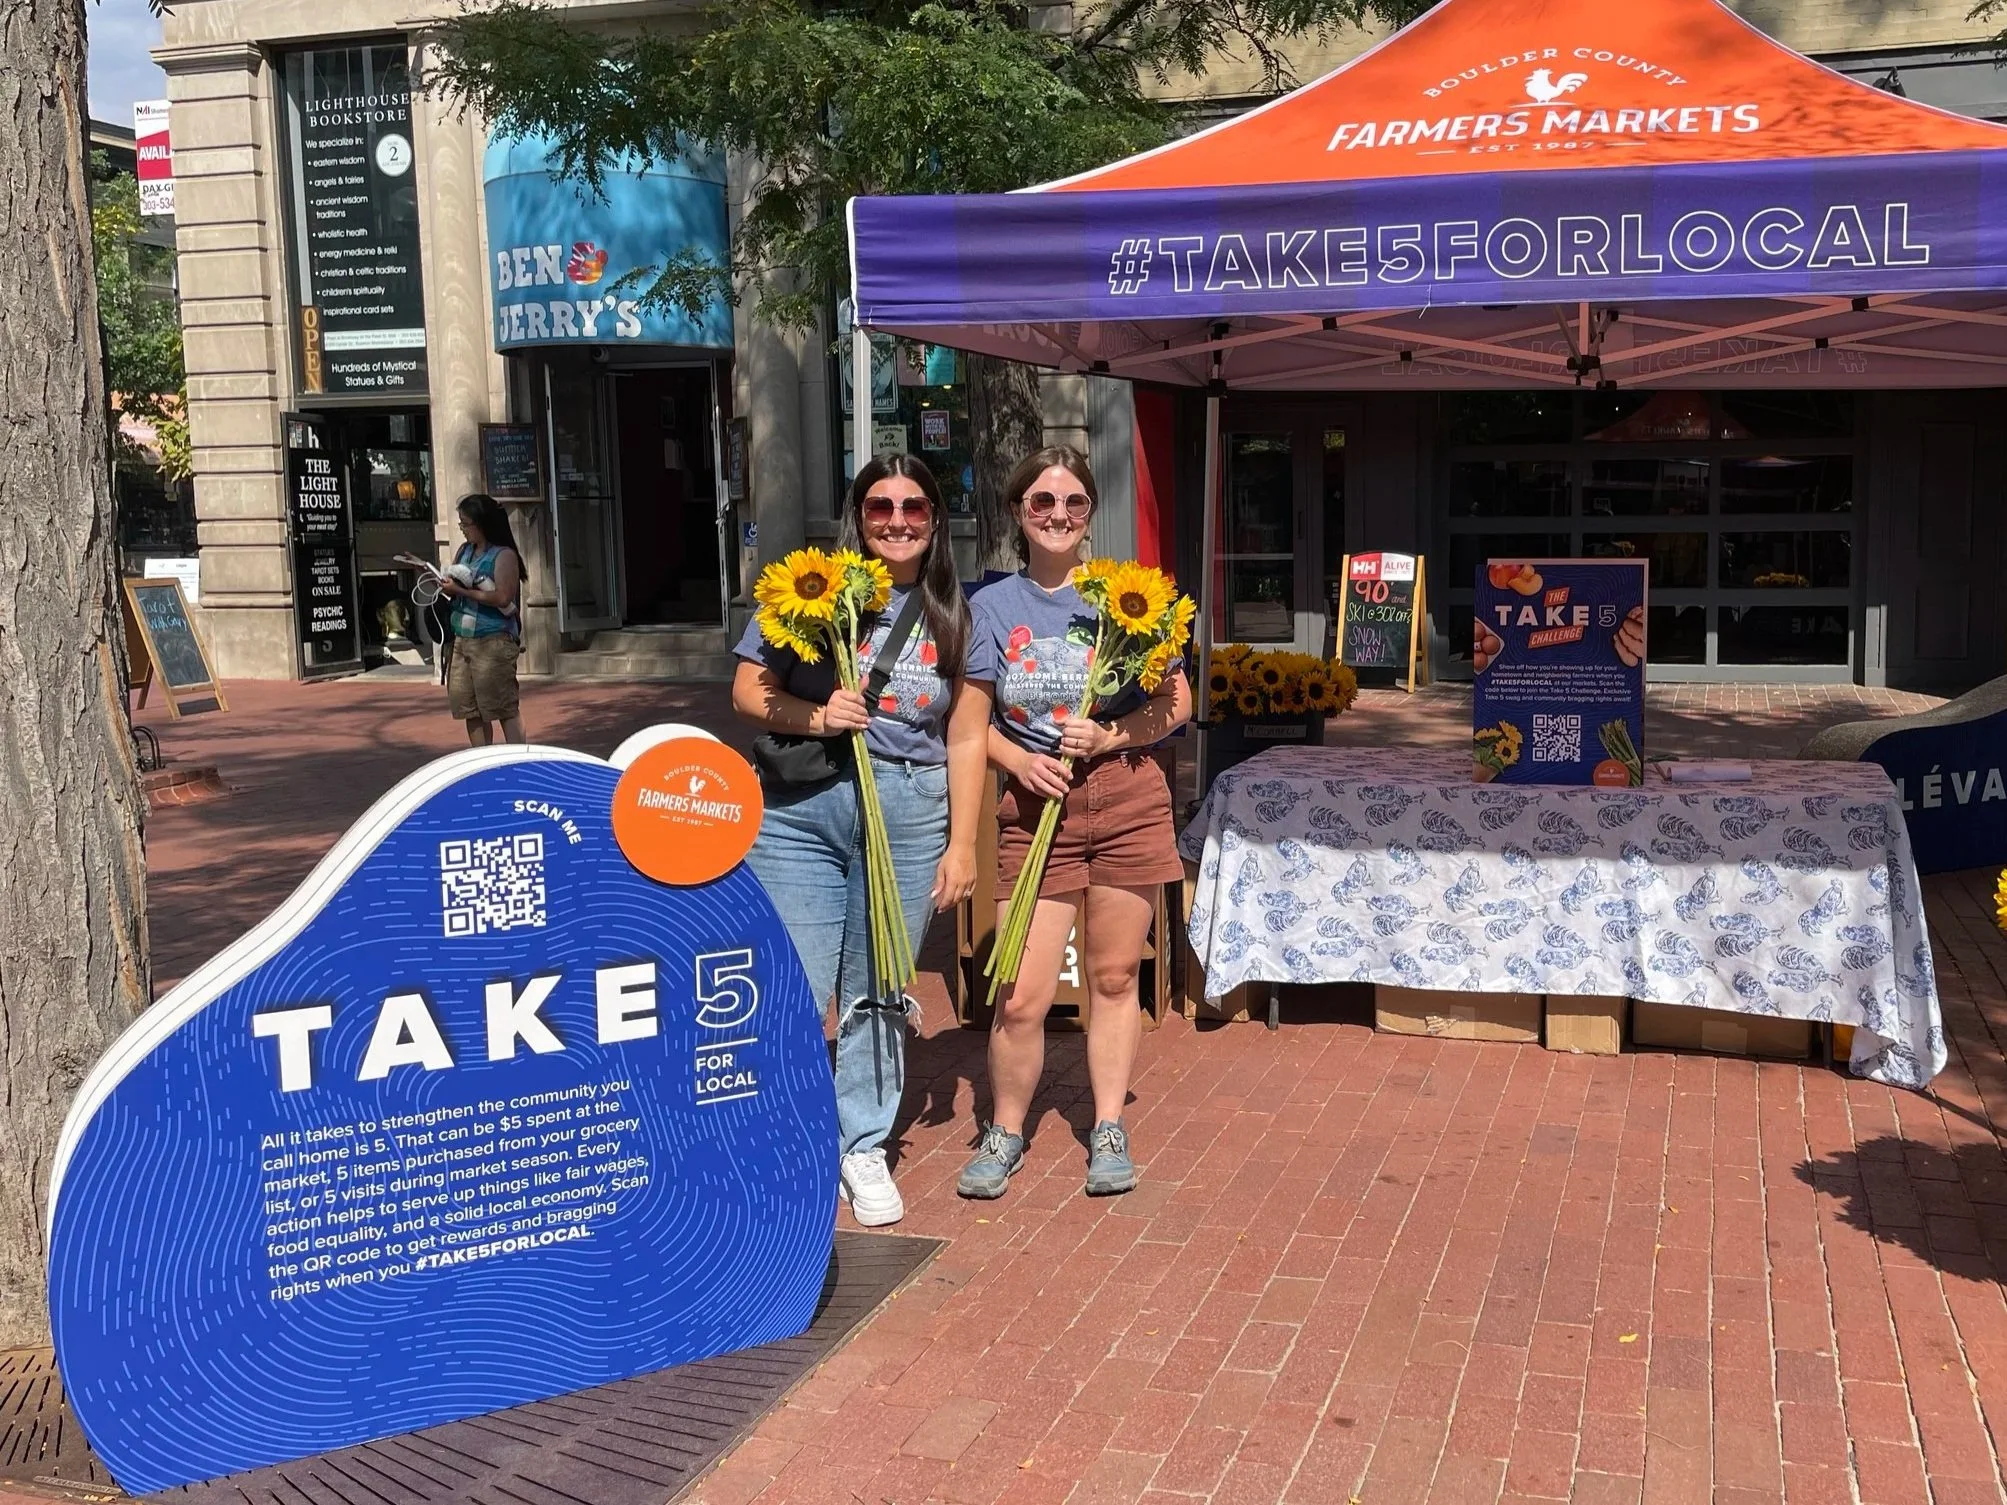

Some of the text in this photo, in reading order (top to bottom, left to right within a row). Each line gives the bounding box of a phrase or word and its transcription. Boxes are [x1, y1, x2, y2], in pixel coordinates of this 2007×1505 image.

[1423, 47, 1687, 99] BOULDER COUNTY
[305, 93, 410, 112] LIGHTHOUSE
[310, 109, 407, 127] BOOKSTORE
[1326, 104, 1761, 152] FARMERS MARKETS
[305, 136, 364, 149] We specialize in:
[1469, 141, 1594, 153] EST 1987
[313, 156, 365, 167] eastern wisdom
[388, 147, 399, 161] 2
[314, 176, 364, 187] angels & fairies
[316, 196, 368, 206] ancient wisdom
[316, 210, 346, 219] traditions
[317, 228, 367, 239] wholistic health
[319, 246, 397, 259] energy medicine & reiki
[1108, 202, 1931, 295] #TAKE5FORLOCAL
[320, 265, 407, 277] christian & celtic traditions
[497, 245, 564, 291] BEN
[353, 286, 386, 296] spirituality
[323, 307, 361, 316] inspirational
[381, 305, 394, 313] sets
[499, 295, 642, 343] JERRY'S
[304, 308, 321, 390] OPEN
[331, 361, 416, 374] Hundreds of Mystical
[345, 375, 404, 386] Statues & Gifts
[305, 459, 331, 474] THE
[300, 476, 338, 491] LIGHT
[299, 494, 341, 508] HOUSE
[1352, 560, 1411, 575] HH ALIVE
[318, 576, 334, 584] BOOKS
[312, 585, 341, 596] ON SALE
[1549, 591, 1565, 602] THE
[313, 606, 343, 618] PSYCHIC
[1346, 602, 1365, 623] SKI
[1494, 605, 1617, 627] TAKE 5
[311, 619, 347, 632] READINGS
[1348, 625, 1382, 646] SNOW
[1531, 628, 1583, 645] CHALLENGE
[1355, 644, 1386, 663] WAY!
[1540, 664, 1558, 672] you're
[664, 765, 730, 791] BOULDER COUNTY
[637, 788, 742, 823] FARMERS MARKETS
[514, 800, 582, 845] SCAN ME
[253, 947, 759, 1093] TAKE 5
[695, 1053, 734, 1073] FOR
[696, 1071, 757, 1094] LOCAL
[261, 1079, 630, 1151] All it takes to strengthen the community you
[262, 1100, 620, 1172] call home is 5. That can be $5 spent at the
[264, 1117, 640, 1193] market, 5 items purchased from your grocery
[265, 1140, 621, 1215] list, or 5 visits during market season. Every
[266, 1156, 649, 1236] action helps to serve up things like fair wages,
[267, 1175, 649, 1258] food equality, and a solid local economy. Scan
[268, 1201, 617, 1279] the QR code to get rewards and bragging
[270, 1220, 595, 1301] rights when you #TAKE5FORLOCAL.
